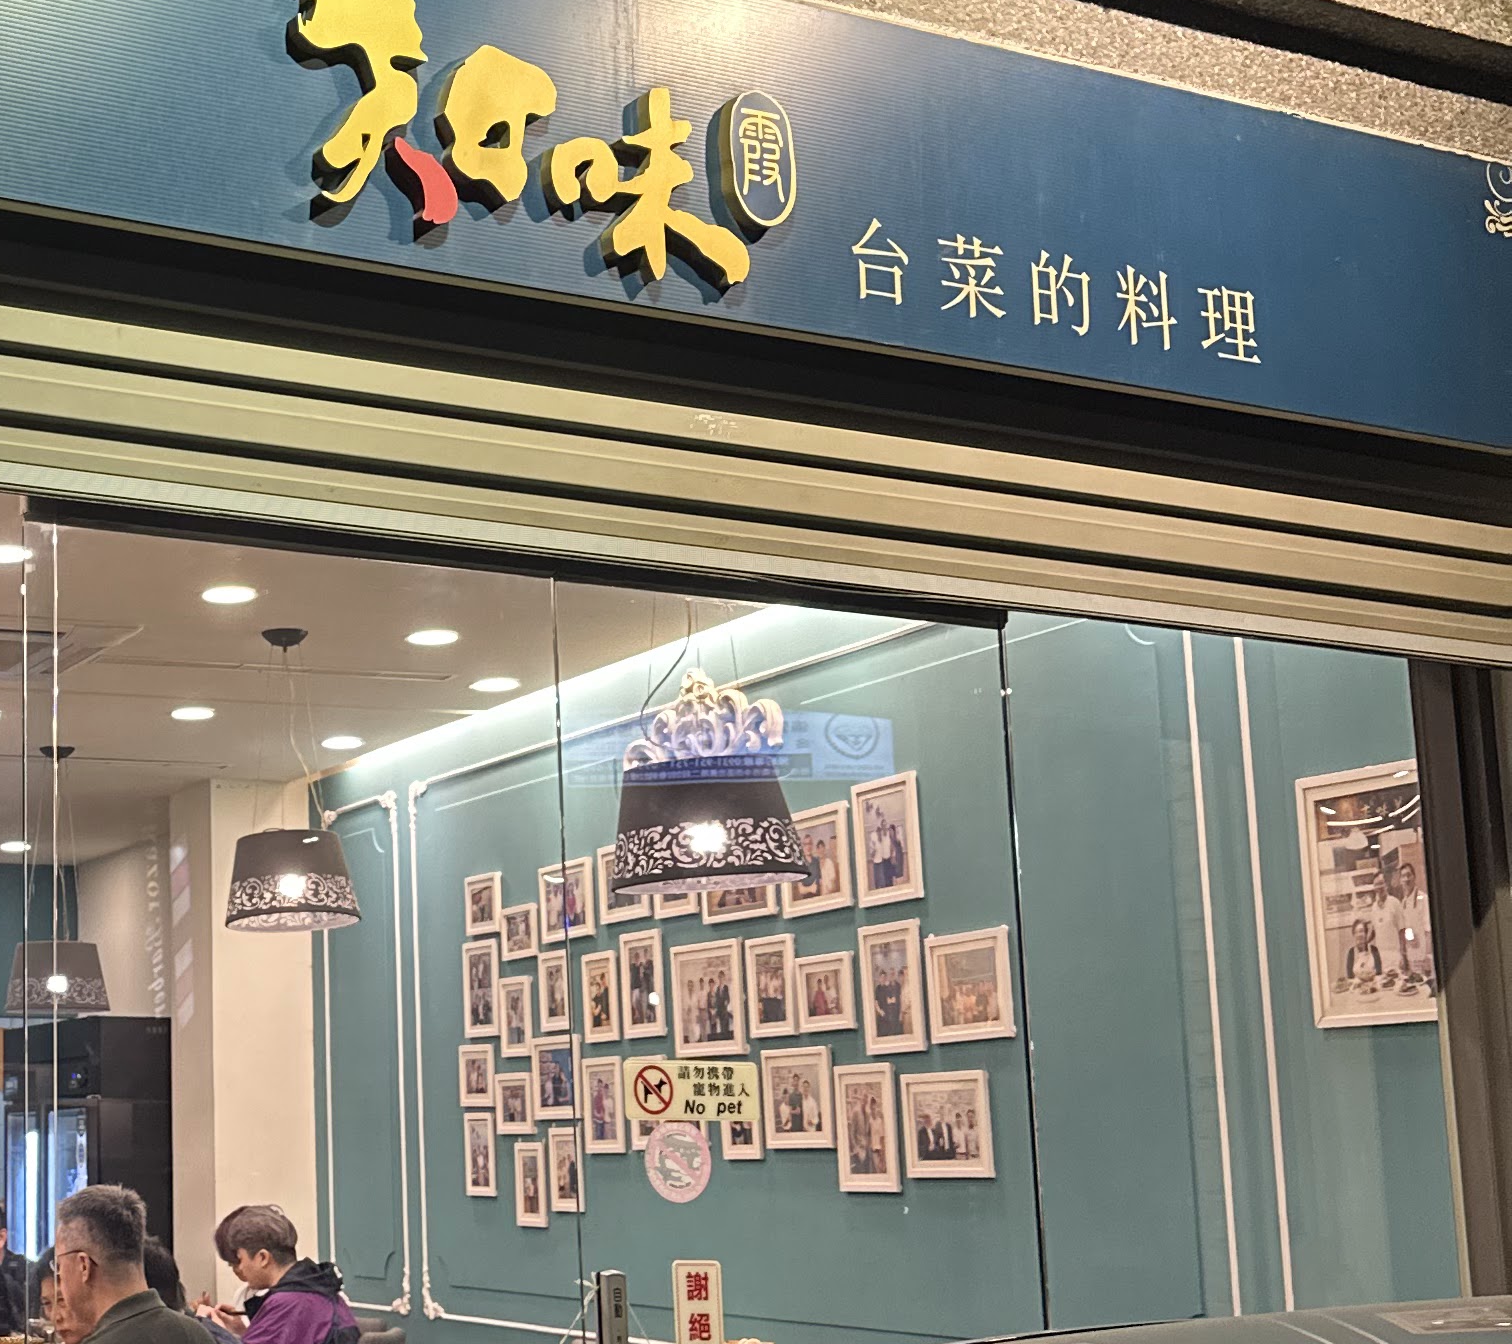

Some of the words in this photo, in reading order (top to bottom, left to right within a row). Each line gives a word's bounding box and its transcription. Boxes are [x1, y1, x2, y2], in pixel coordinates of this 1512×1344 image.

[739, 106, 785, 204] 霞
[851, 217, 1262, 366] 台菜的料理
[683, 1099, 706, 1115] No
[716, 1100, 743, 1117] pet
